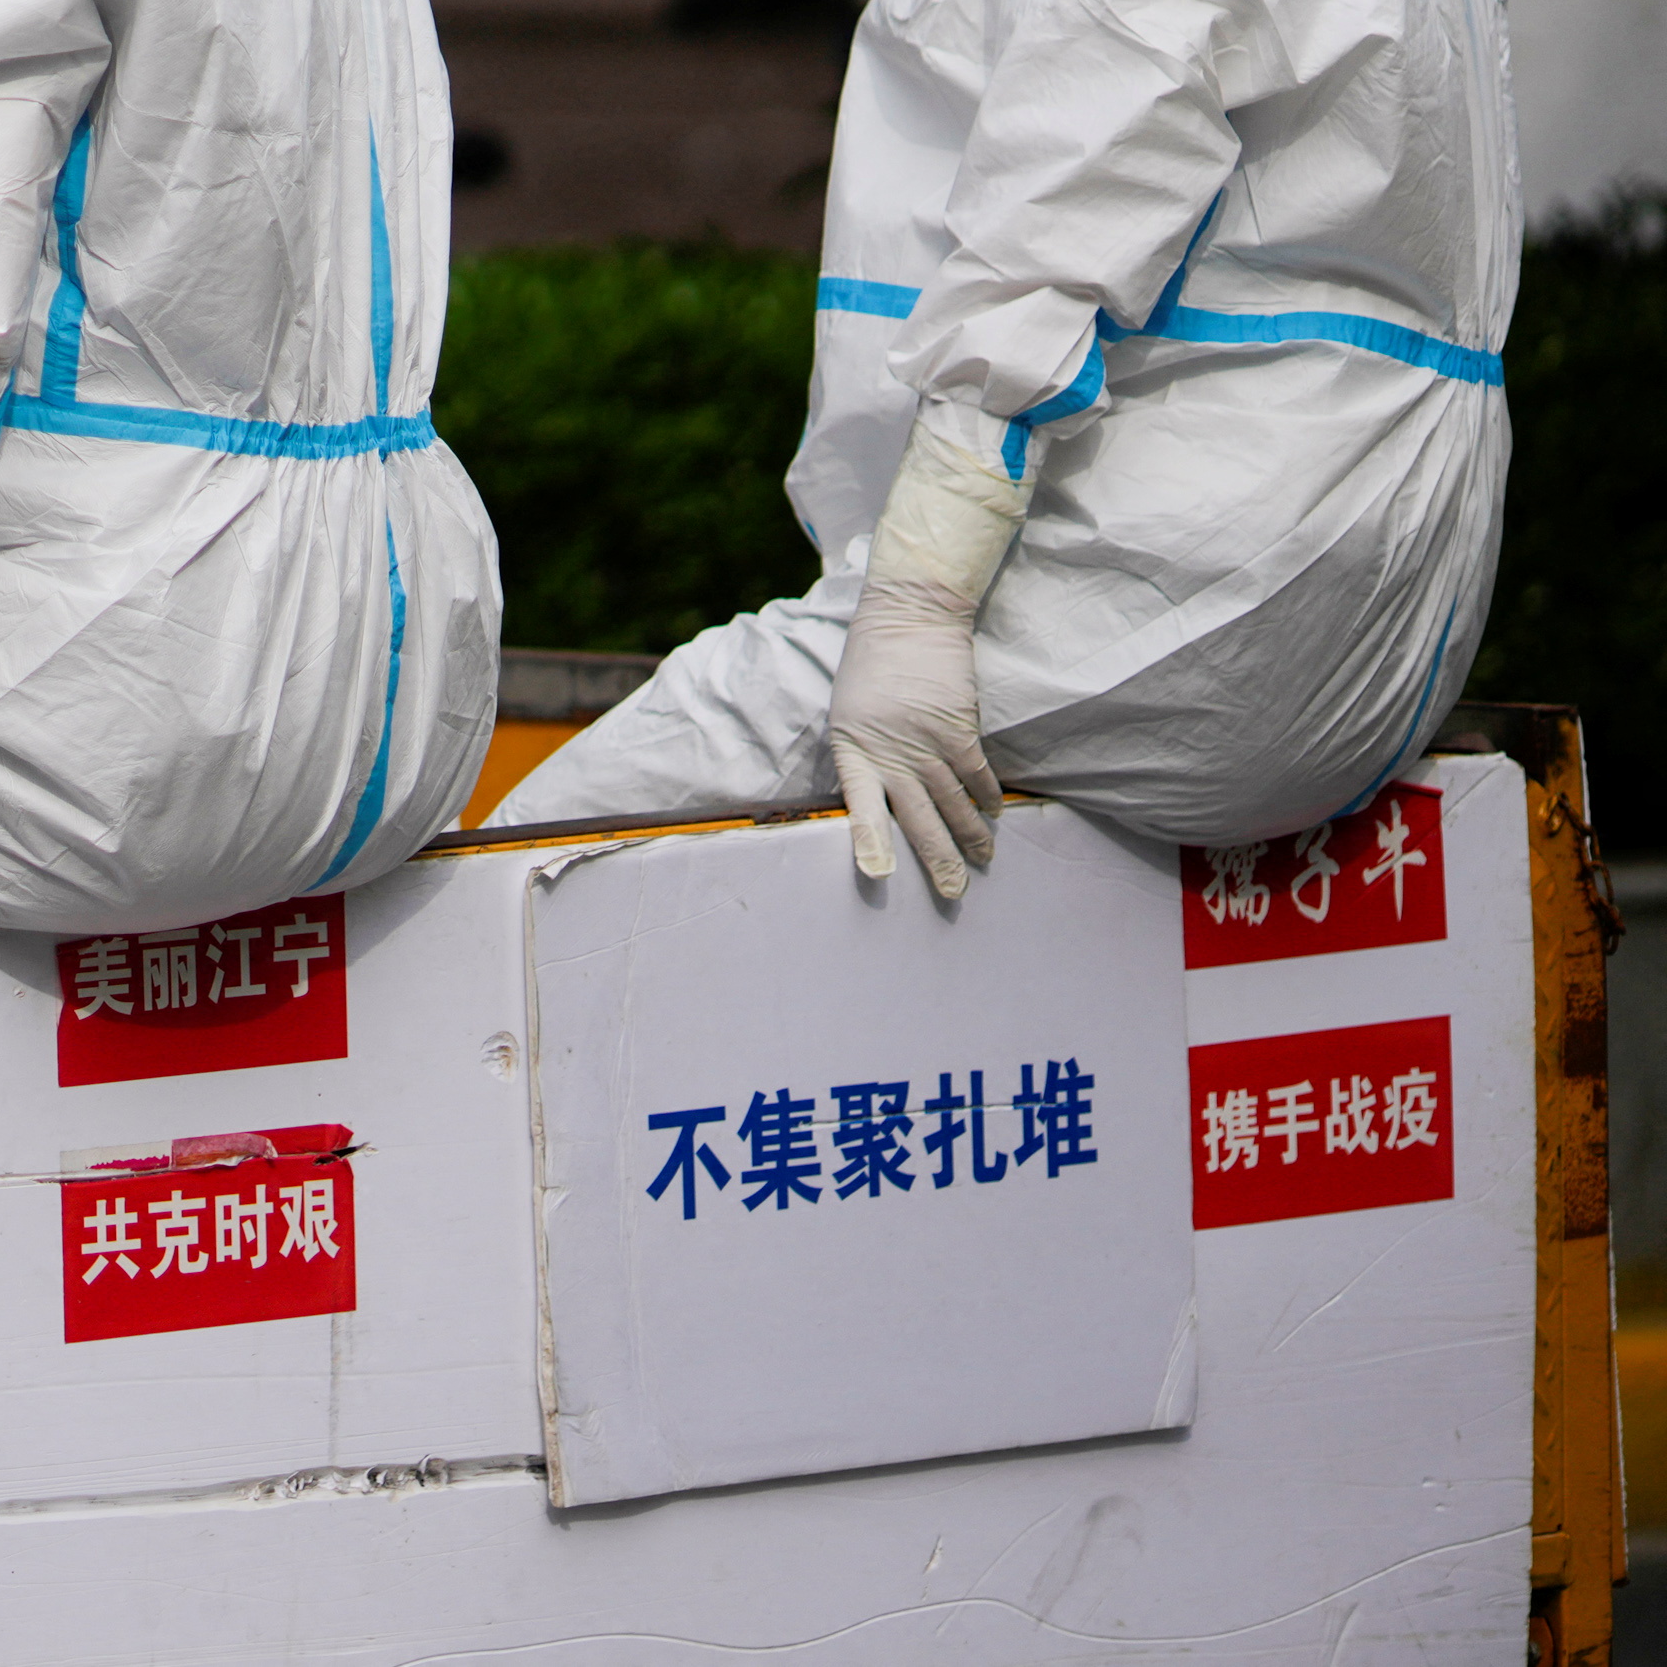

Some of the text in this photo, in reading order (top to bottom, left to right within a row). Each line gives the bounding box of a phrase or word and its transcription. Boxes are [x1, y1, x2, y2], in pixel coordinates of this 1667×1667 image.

[74, 913, 331, 1021] 美丽江宁
[645, 1056, 1099, 1221] 不集聚扎堆
[1201, 1066, 1439, 1174] 携手战疫
[80, 1177, 341, 1286] 共克时艰
